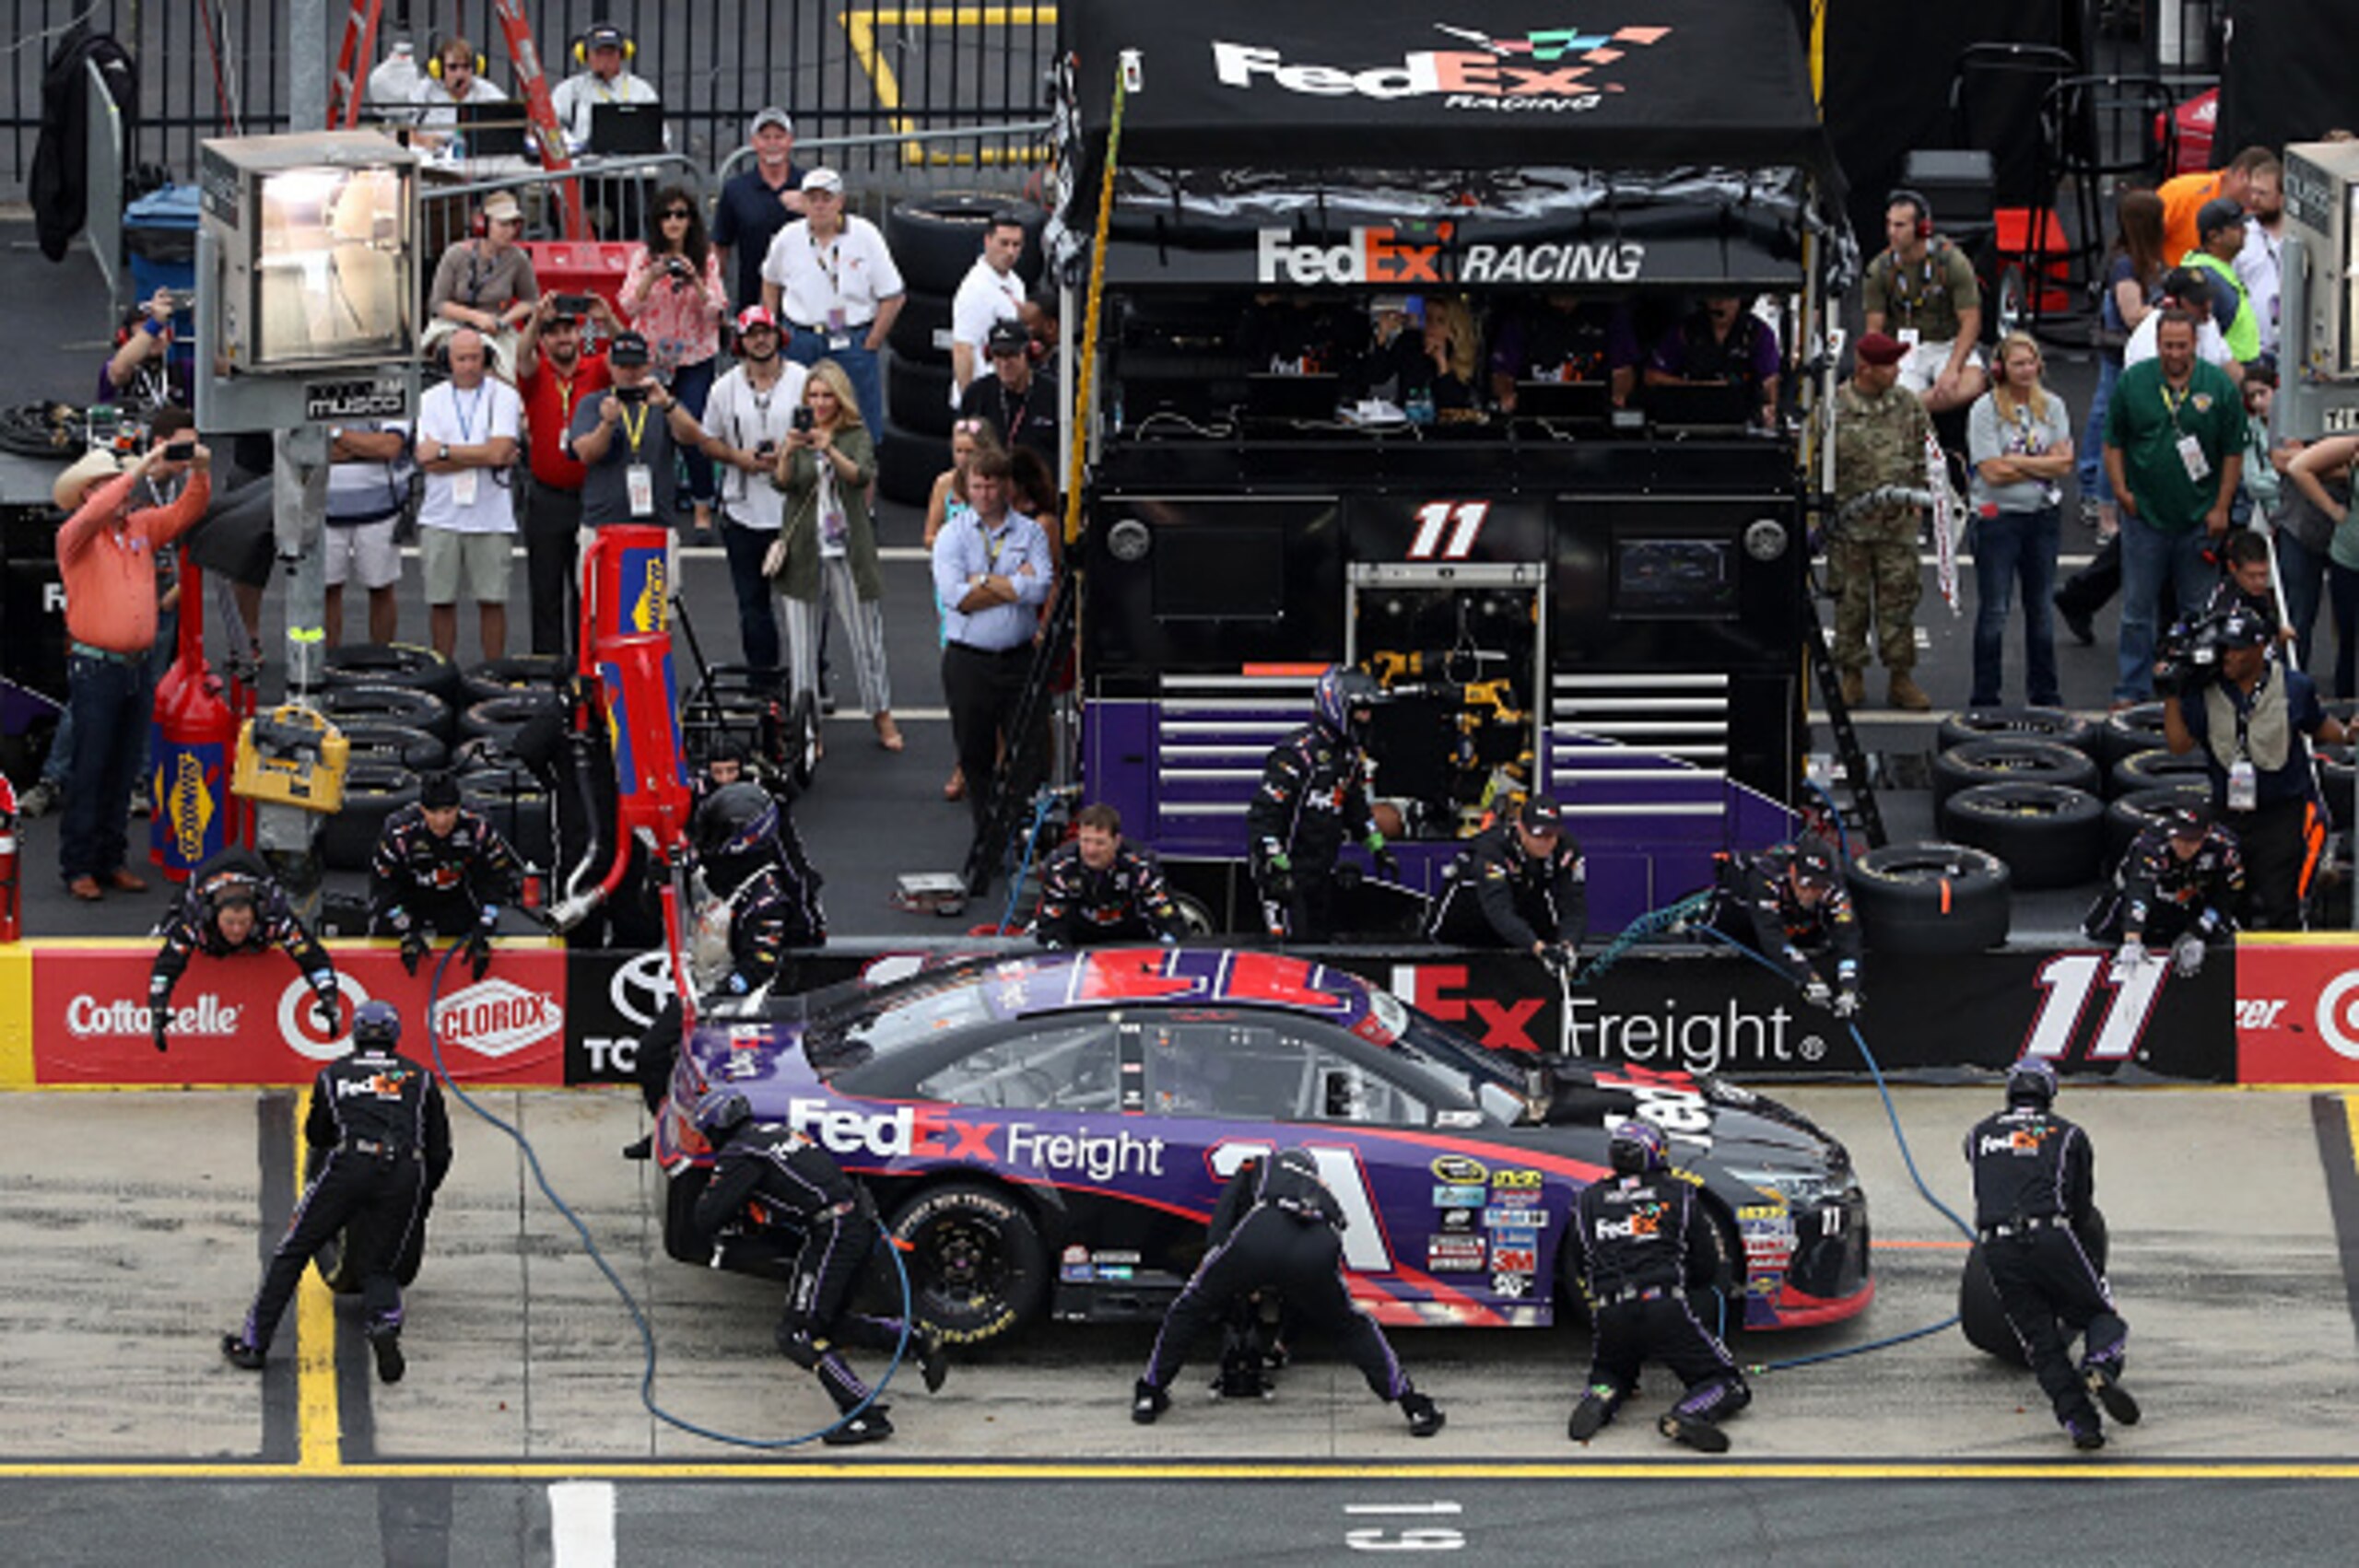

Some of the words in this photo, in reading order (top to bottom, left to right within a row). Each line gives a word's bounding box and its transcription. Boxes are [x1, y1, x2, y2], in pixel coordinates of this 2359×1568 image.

[1211, 41, 1597, 99] FedEx
[1257, 227, 1440, 284] FedEx
[1461, 244, 1645, 283] RACING
[1405, 499, 1492, 560] 11
[441, 995, 546, 1042] CLOROX
[2017, 948, 2173, 1059] 11
[1561, 998, 1792, 1075] Freight
[790, 1099, 1000, 1162] FedEx
[1007, 1121, 1164, 1182] Freight
[1595, 1213, 1660, 1240] FedEx
